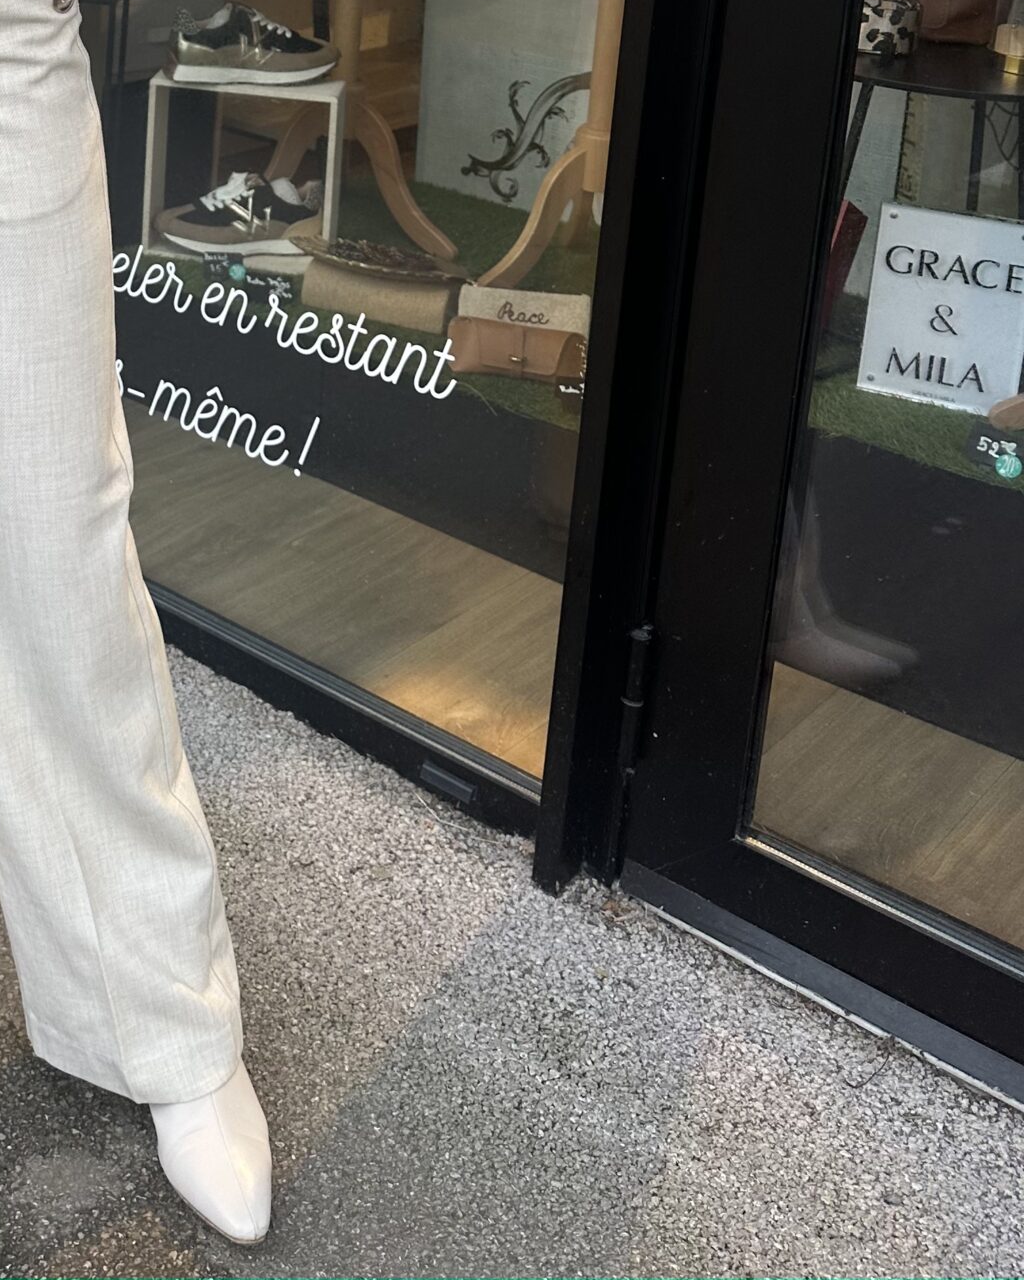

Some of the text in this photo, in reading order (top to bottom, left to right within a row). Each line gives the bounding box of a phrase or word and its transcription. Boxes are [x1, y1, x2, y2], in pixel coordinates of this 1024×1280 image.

[884, 244, 1024, 295] GRACE
[497, 300, 550, 326] Peace
[929, 303, 959, 336] &
[200, 281, 258, 335] en
[264, 293, 458, 400] restant
[885, 346, 985, 393] MILA
